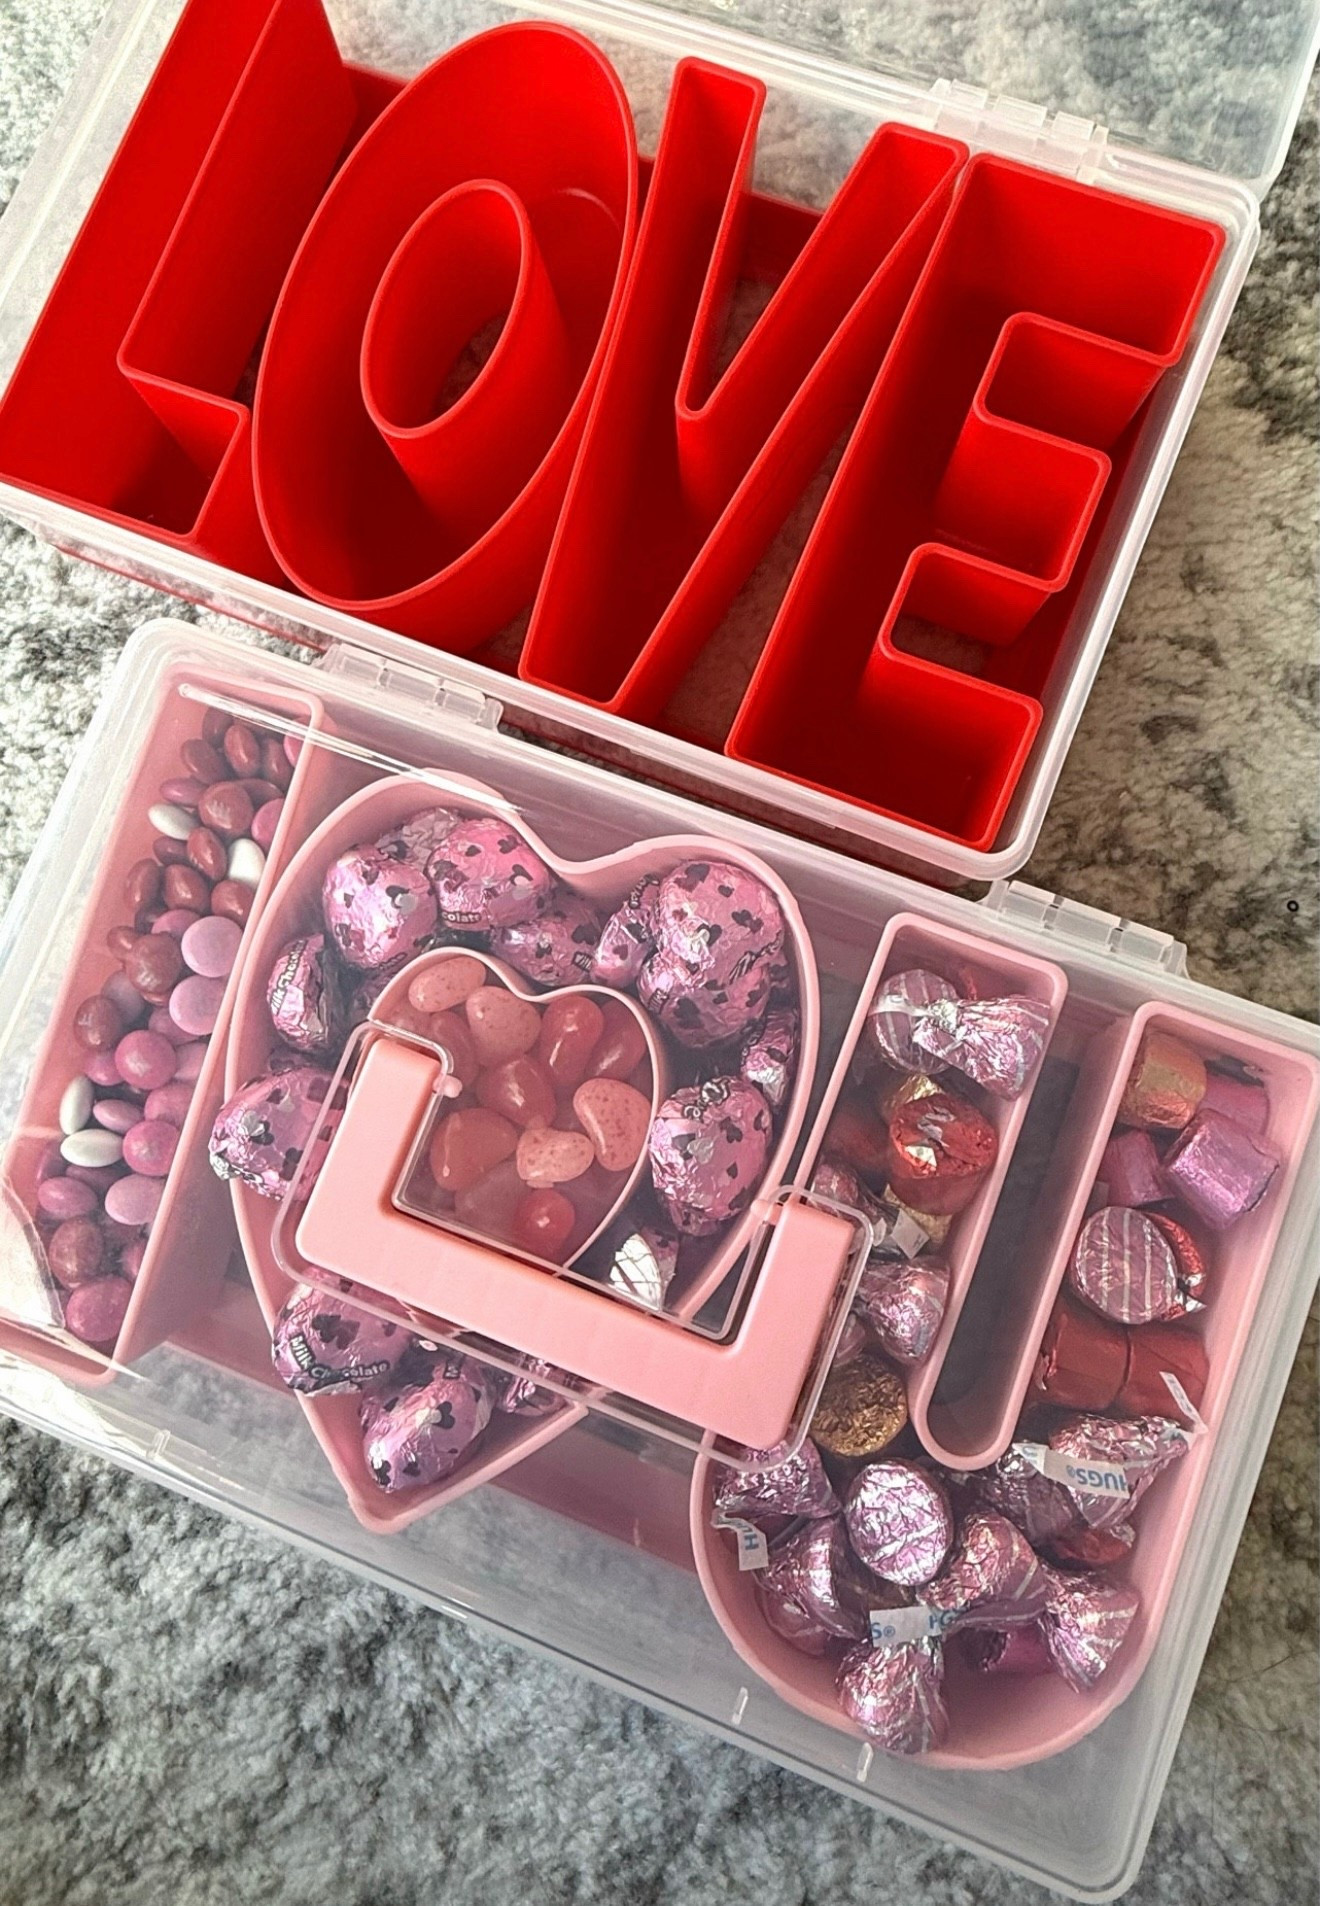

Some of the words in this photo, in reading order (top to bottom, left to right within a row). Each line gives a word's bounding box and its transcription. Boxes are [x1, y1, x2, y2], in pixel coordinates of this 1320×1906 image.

[0, 0, 1226, 850] LOVE
[289, 1335, 314, 1369] Milk
[311, 1361, 388, 1379] Chcolate
